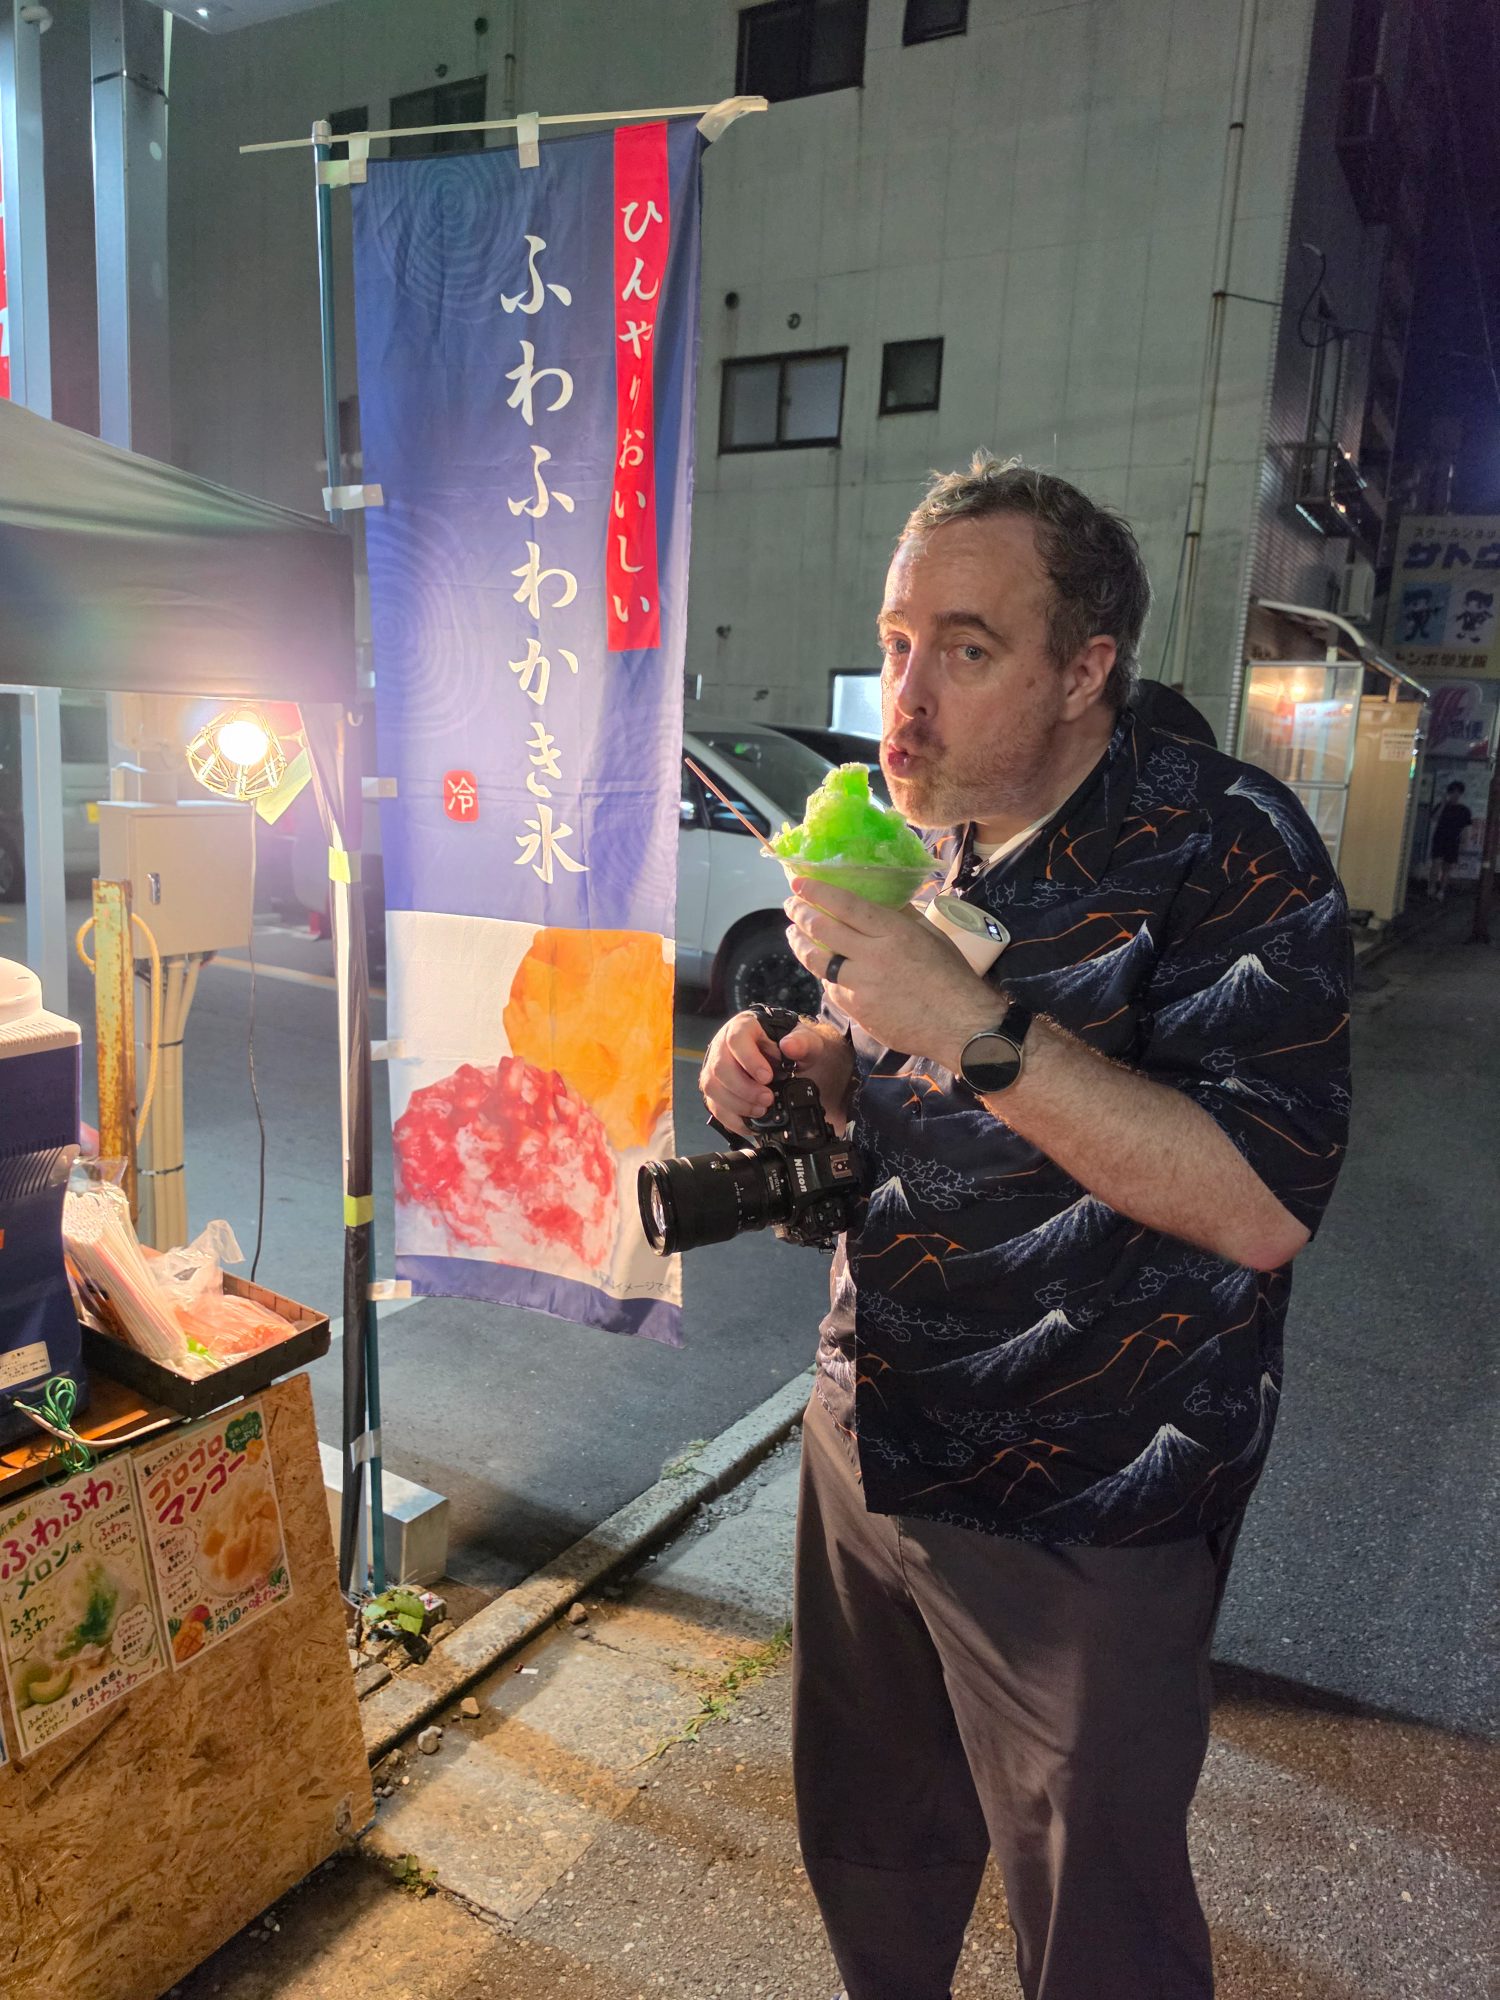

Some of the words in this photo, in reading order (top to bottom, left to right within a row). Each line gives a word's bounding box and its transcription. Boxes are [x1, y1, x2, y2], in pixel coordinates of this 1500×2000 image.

[613, 200, 662, 622] ひんやりおいしい
[500, 235, 590, 884] ふわふわかき氷
[447, 776, 476, 815] 冷
[793, 1158, 808, 1193] Nikon
[148, 1434, 223, 1512] ゴロゴロ
[158, 1452, 246, 1525] マンゴー
[1, 1477, 114, 1579] ふわふわ
[16, 1540, 85, 1600] メロン味
[71, 1668, 123, 1710] 見た目も食感も
